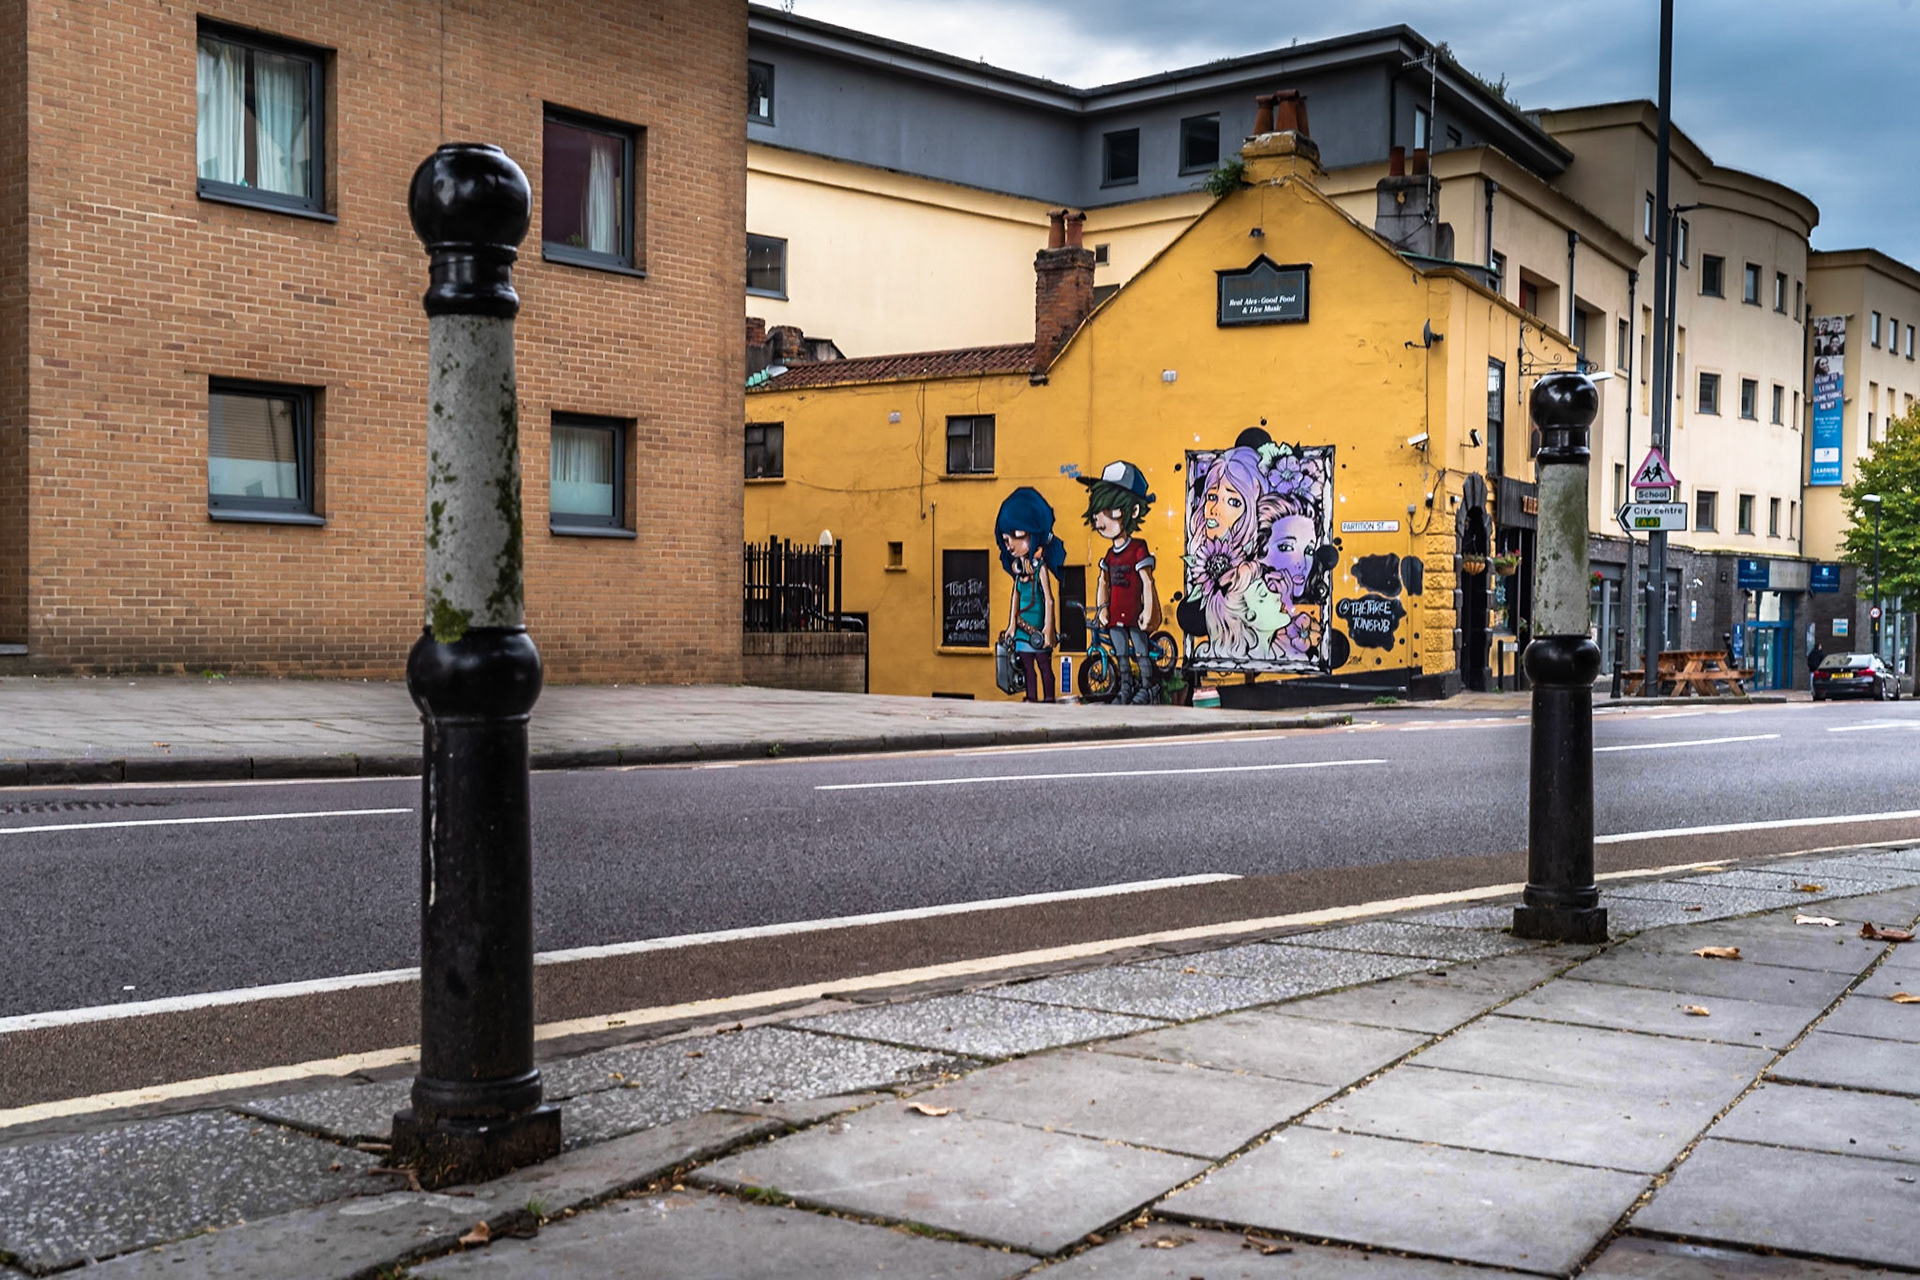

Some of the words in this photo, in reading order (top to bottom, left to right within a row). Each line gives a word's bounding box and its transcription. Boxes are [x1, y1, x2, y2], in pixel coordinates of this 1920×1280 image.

[1279, 295, 1296, 303] Food
[1634, 507, 1651, 515] City
[1654, 507, 1683, 515] centre
[1343, 522, 1374, 531] PARTITION
[1377, 521, 1385, 530] ST
